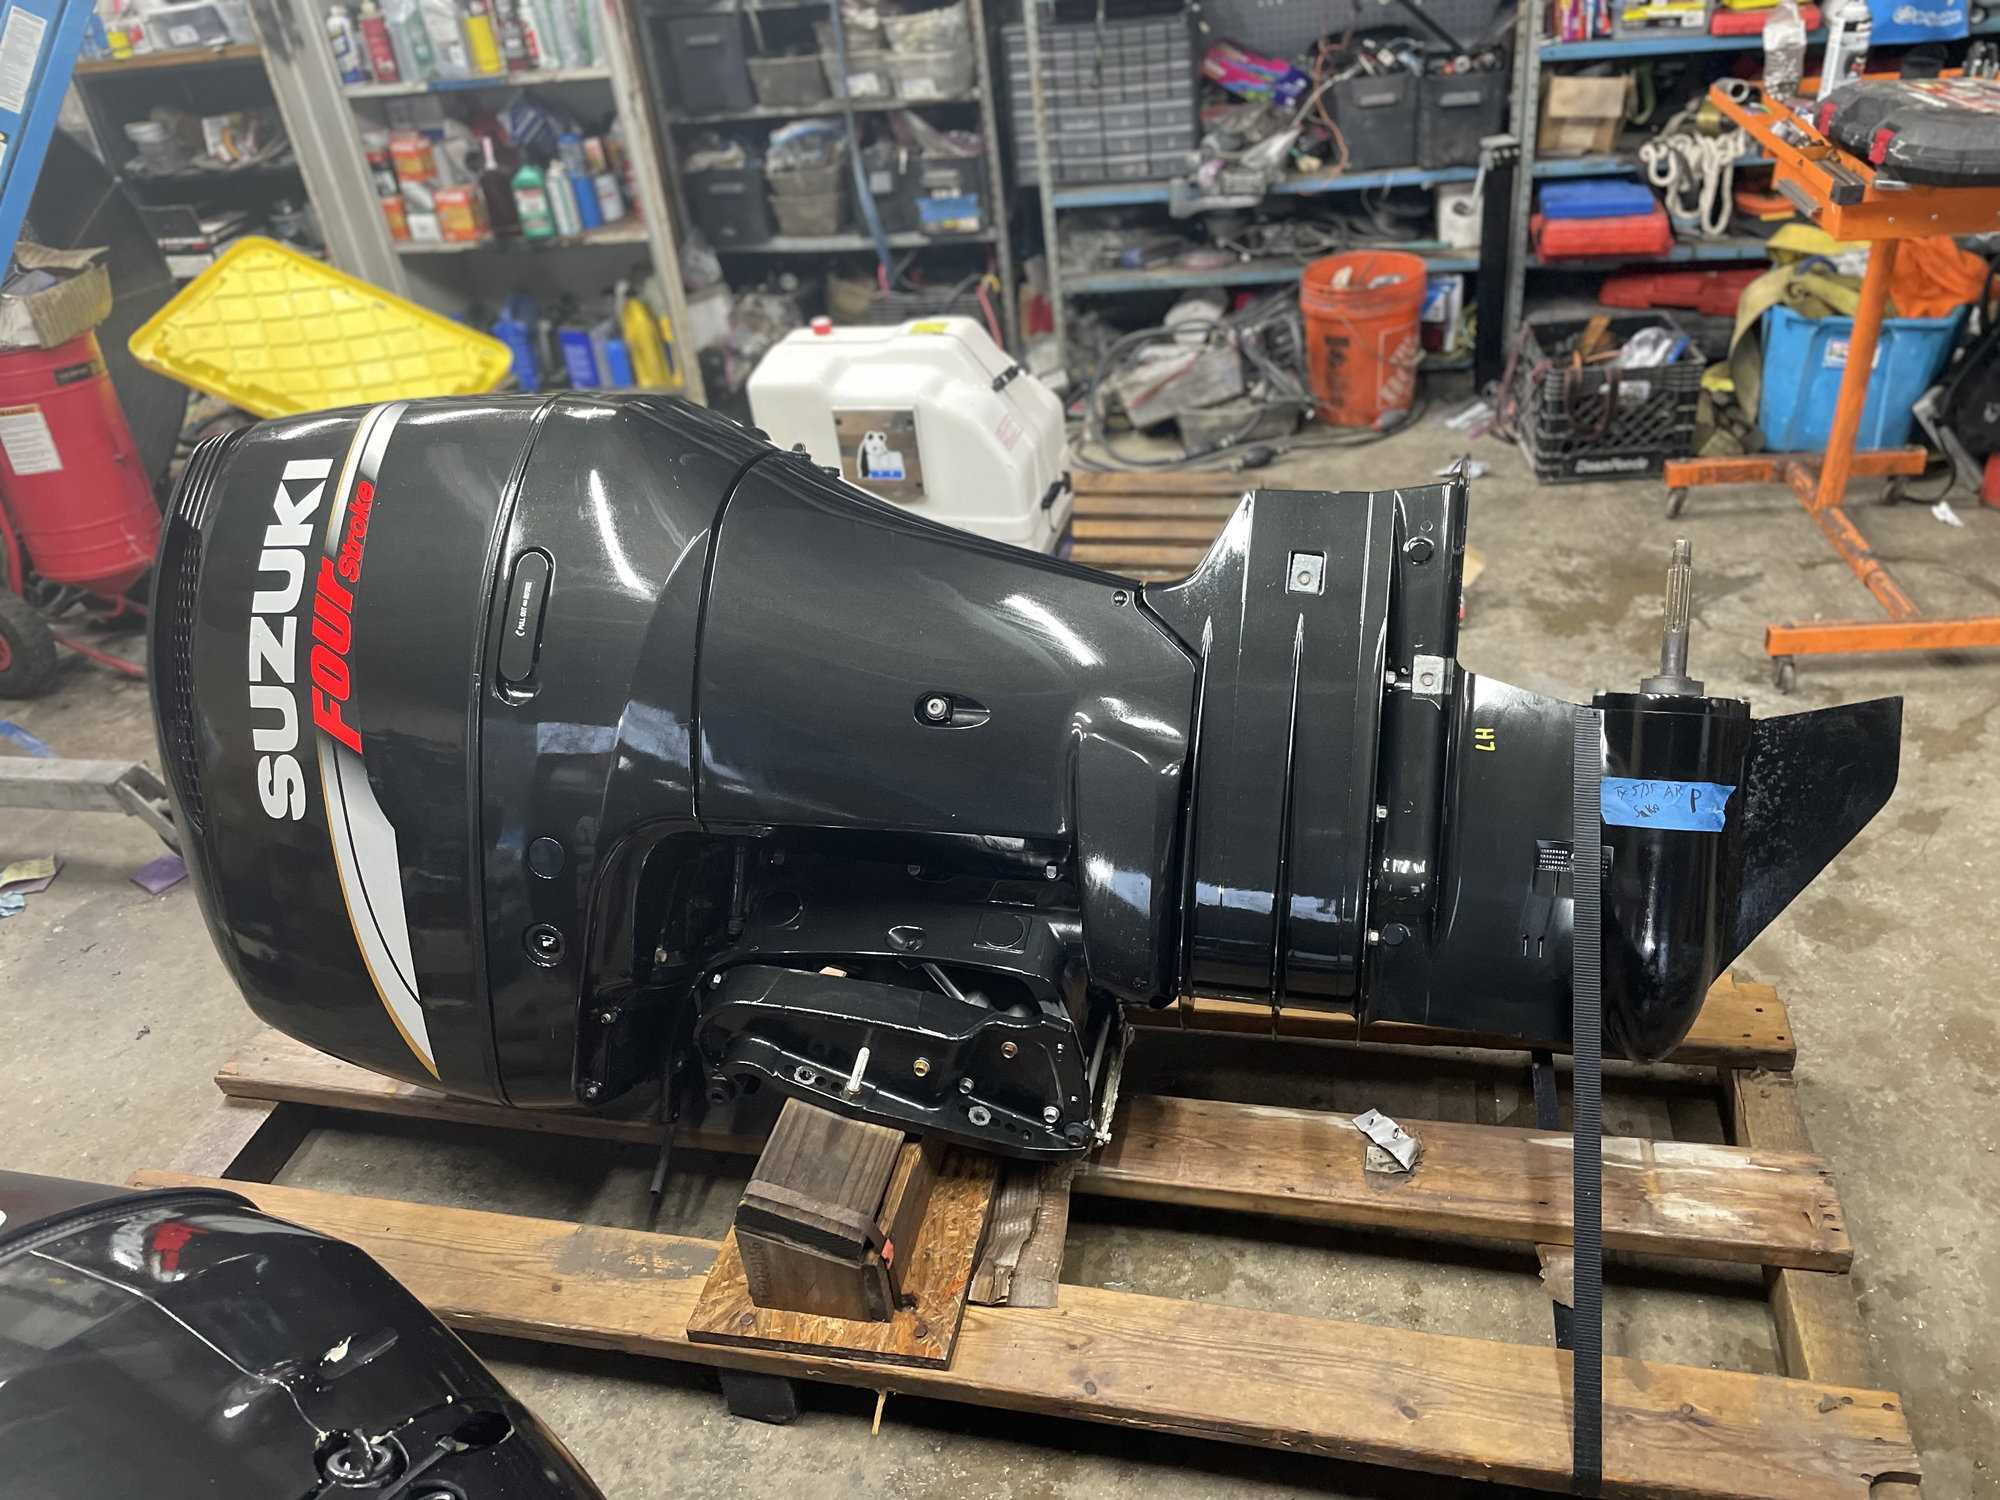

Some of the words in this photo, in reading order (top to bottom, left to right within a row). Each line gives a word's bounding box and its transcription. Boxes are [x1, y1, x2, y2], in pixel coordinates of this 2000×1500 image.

[336, 480, 375, 583] Stroke
[249, 457, 334, 822] SUZUKI
[1690, 787, 1703, 816] P
